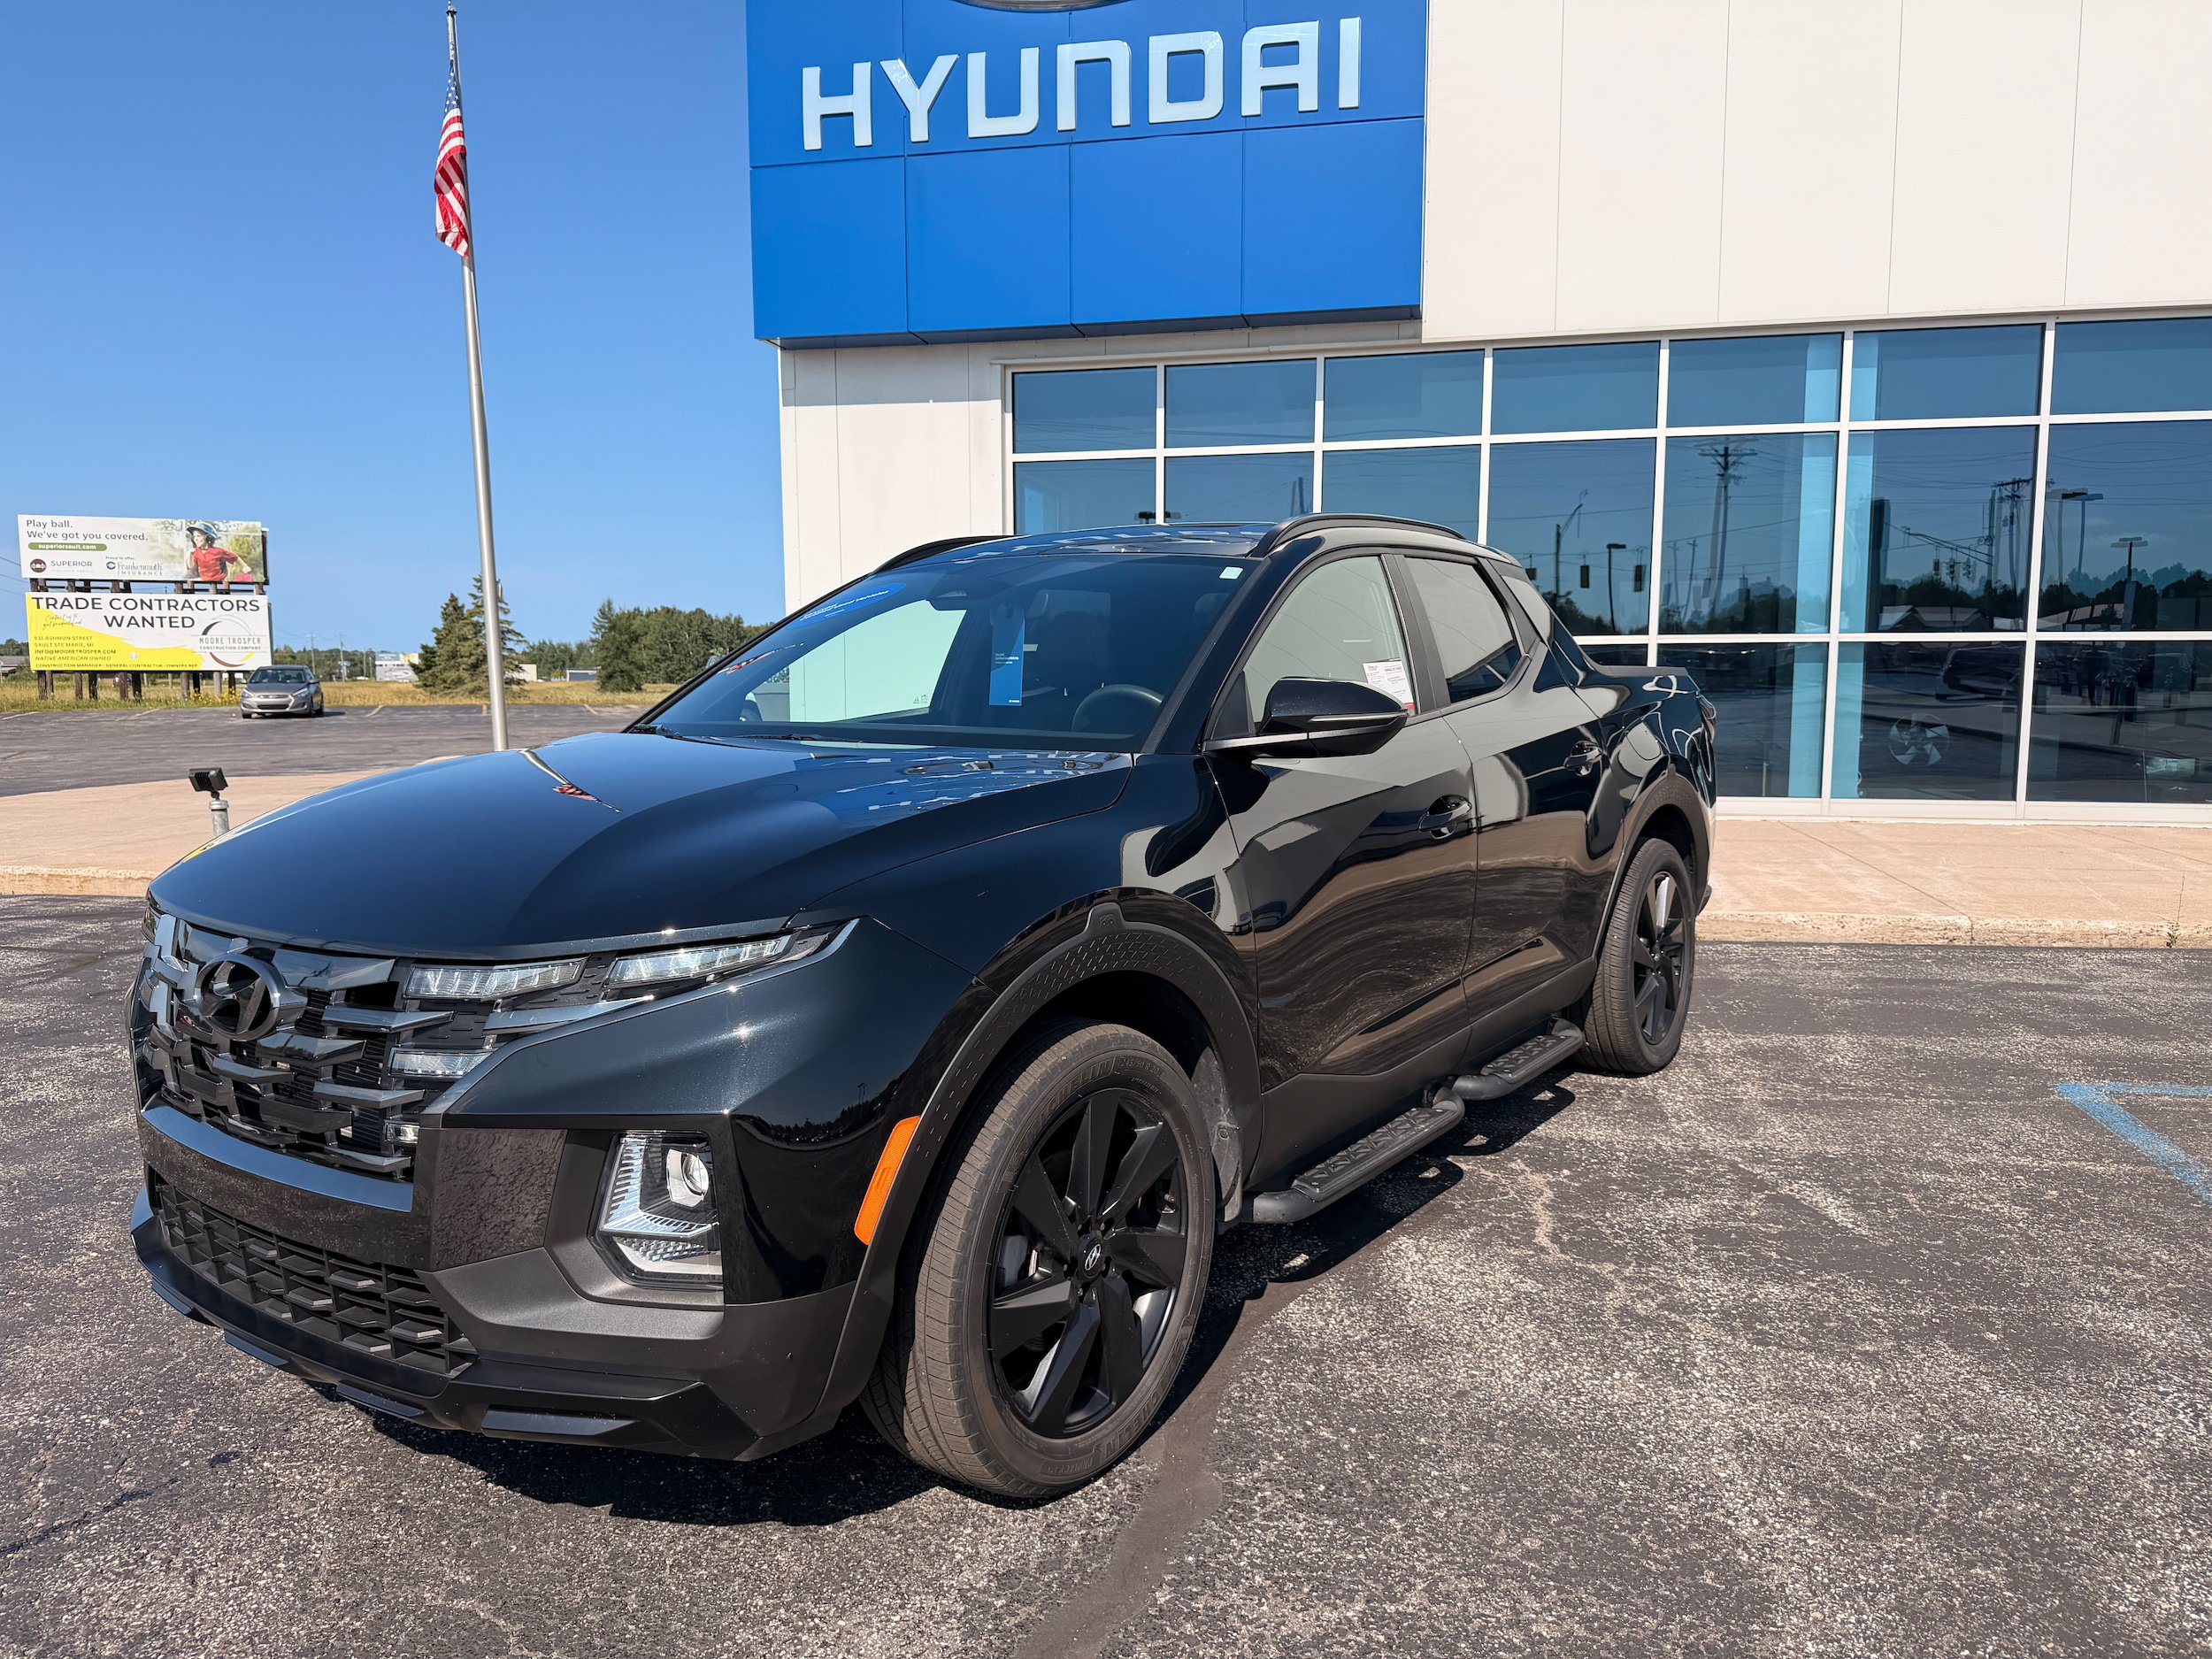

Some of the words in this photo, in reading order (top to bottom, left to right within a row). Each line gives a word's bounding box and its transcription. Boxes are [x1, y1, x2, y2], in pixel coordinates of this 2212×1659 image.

[803, 17, 1362, 150] HYUNDAI
[27, 519, 47, 529] Play
[50, 519, 73, 528] ball.
[62, 532, 79, 541] got
[105, 533, 149, 541] covered.
[117, 561, 161, 571] Frankenmuth
[32, 597, 103, 610] TRADE
[109, 598, 260, 611] CONTRACTORS
[104, 615, 196, 628] WANTED
